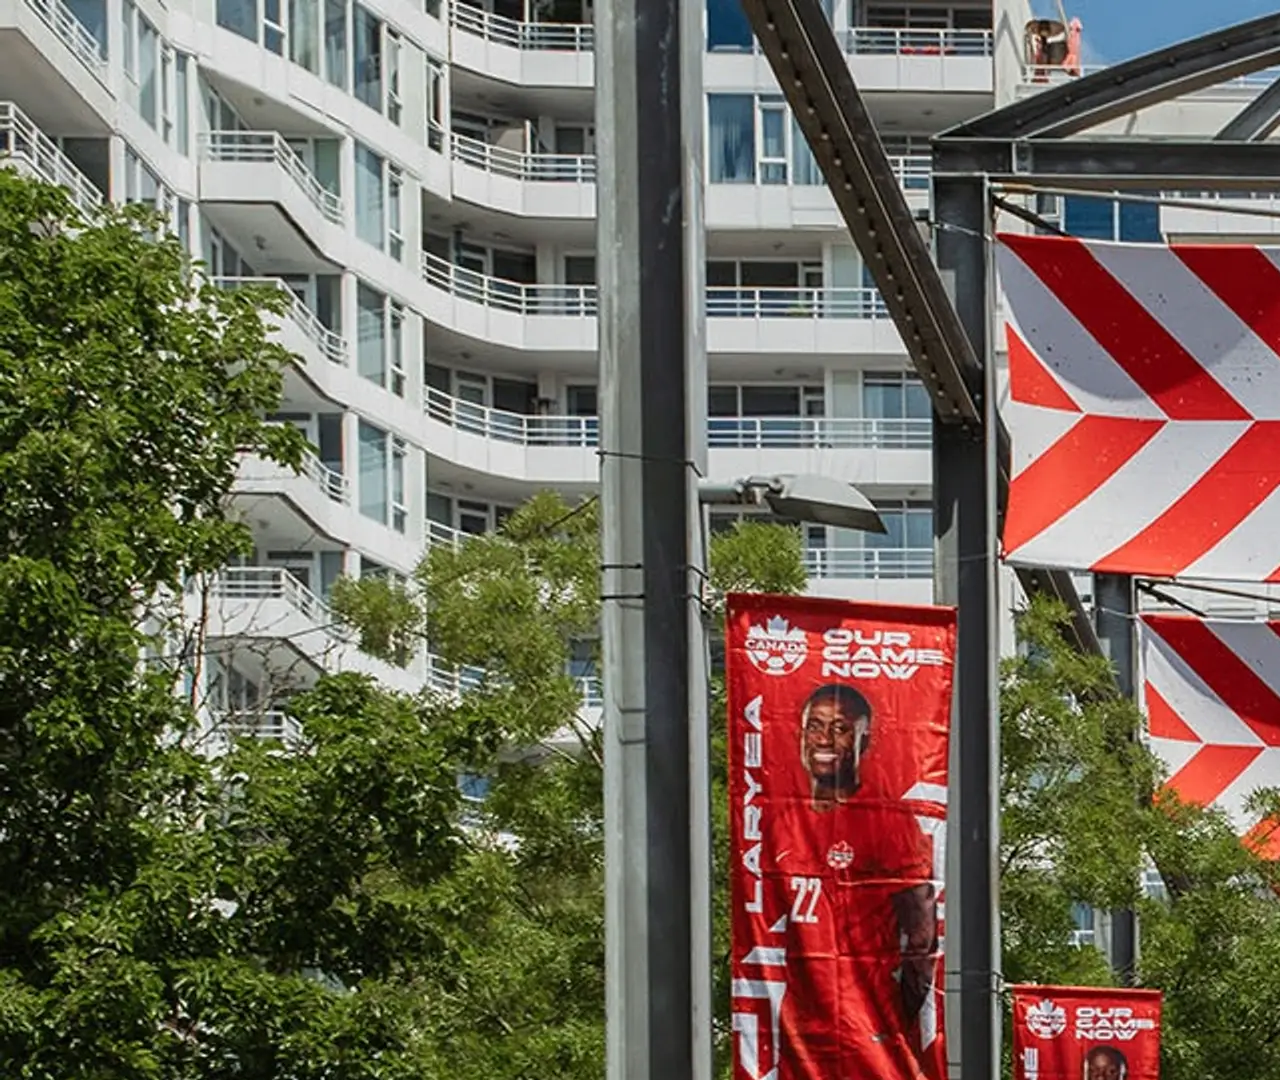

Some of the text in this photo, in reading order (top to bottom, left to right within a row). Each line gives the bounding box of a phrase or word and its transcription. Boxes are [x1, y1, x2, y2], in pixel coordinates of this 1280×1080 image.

[823, 629, 911, 646] OUR
[744, 639, 809, 654] CANADA
[822, 646, 945, 666] GAME
[822, 663, 920, 680] NOW
[743, 695, 763, 914] LARYEA
[790, 877, 822, 923] 22
[1075, 1007, 1132, 1018] OUR
[1075, 1018, 1155, 1029] GAME
[1075, 1029, 1139, 1041] NOW
